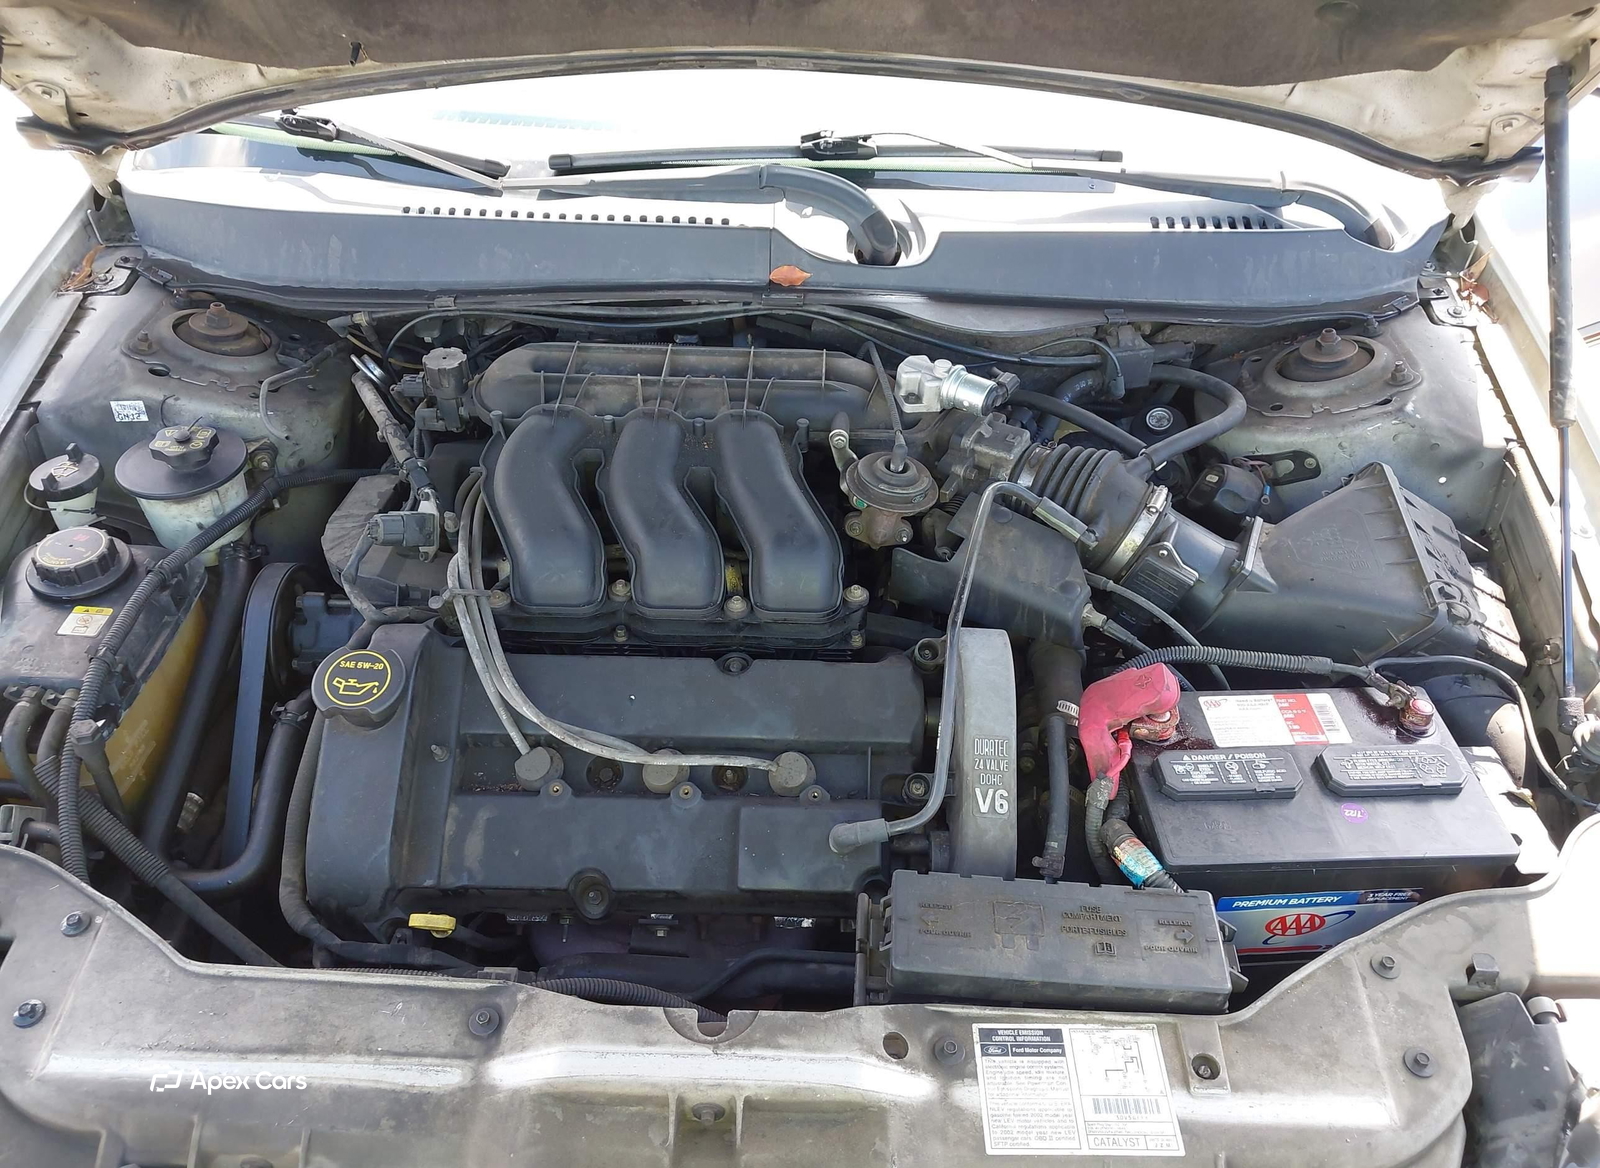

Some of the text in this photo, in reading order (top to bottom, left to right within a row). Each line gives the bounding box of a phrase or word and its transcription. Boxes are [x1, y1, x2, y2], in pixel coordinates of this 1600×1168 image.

[357, 662, 384, 670] 5W-20
[974, 738, 1008, 756] DURATEC
[974, 759, 1008, 771] 24 VALVE
[981, 773, 1002, 785] DOHC
[975, 788, 1008, 814] V6
[1232, 896, 1343, 908] PREMIUM BATTERY
[1062, 912, 1121, 922] COMPARTMENT
[1270, 914, 1320, 935] AAA
[1094, 1137, 1140, 1147] CATALYST
